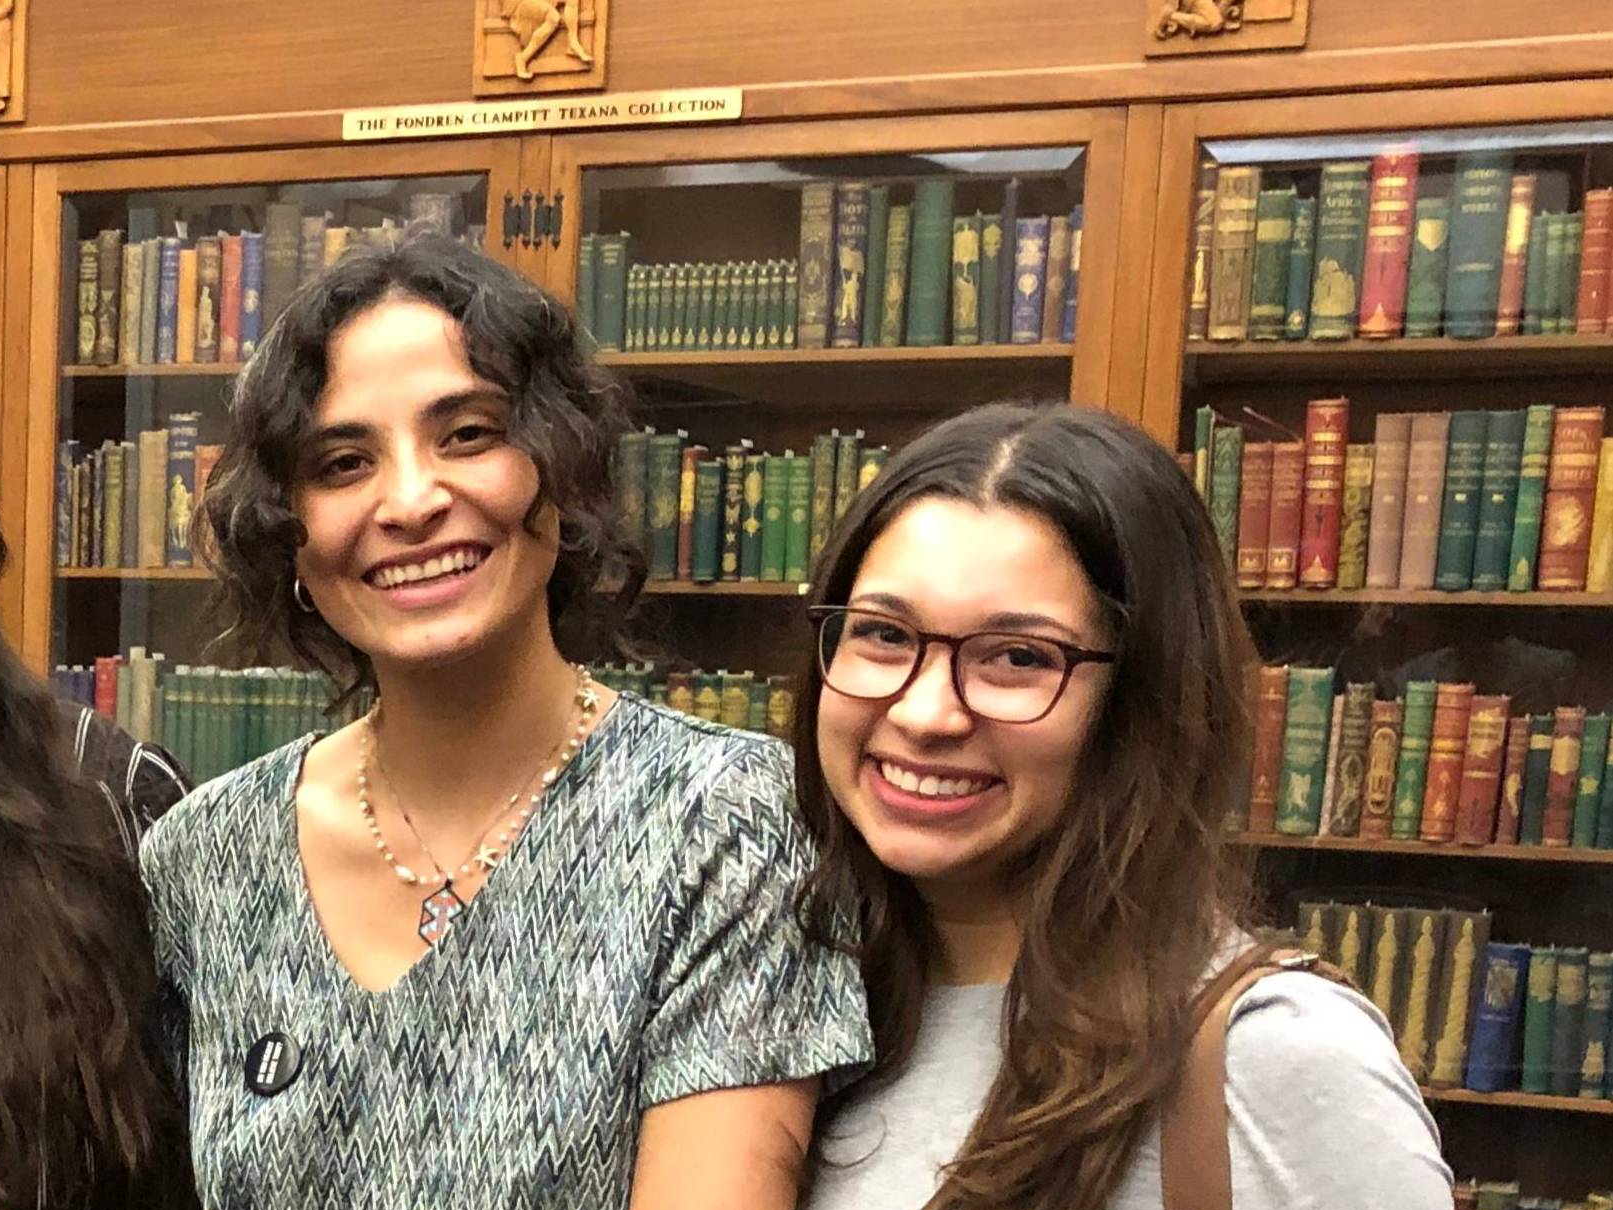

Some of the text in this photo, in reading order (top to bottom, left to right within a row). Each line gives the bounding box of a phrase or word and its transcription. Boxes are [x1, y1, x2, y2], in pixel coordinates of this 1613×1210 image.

[357, 99, 726, 131] THE FONDREN CLAMPITT TEXANA COLLECTION
